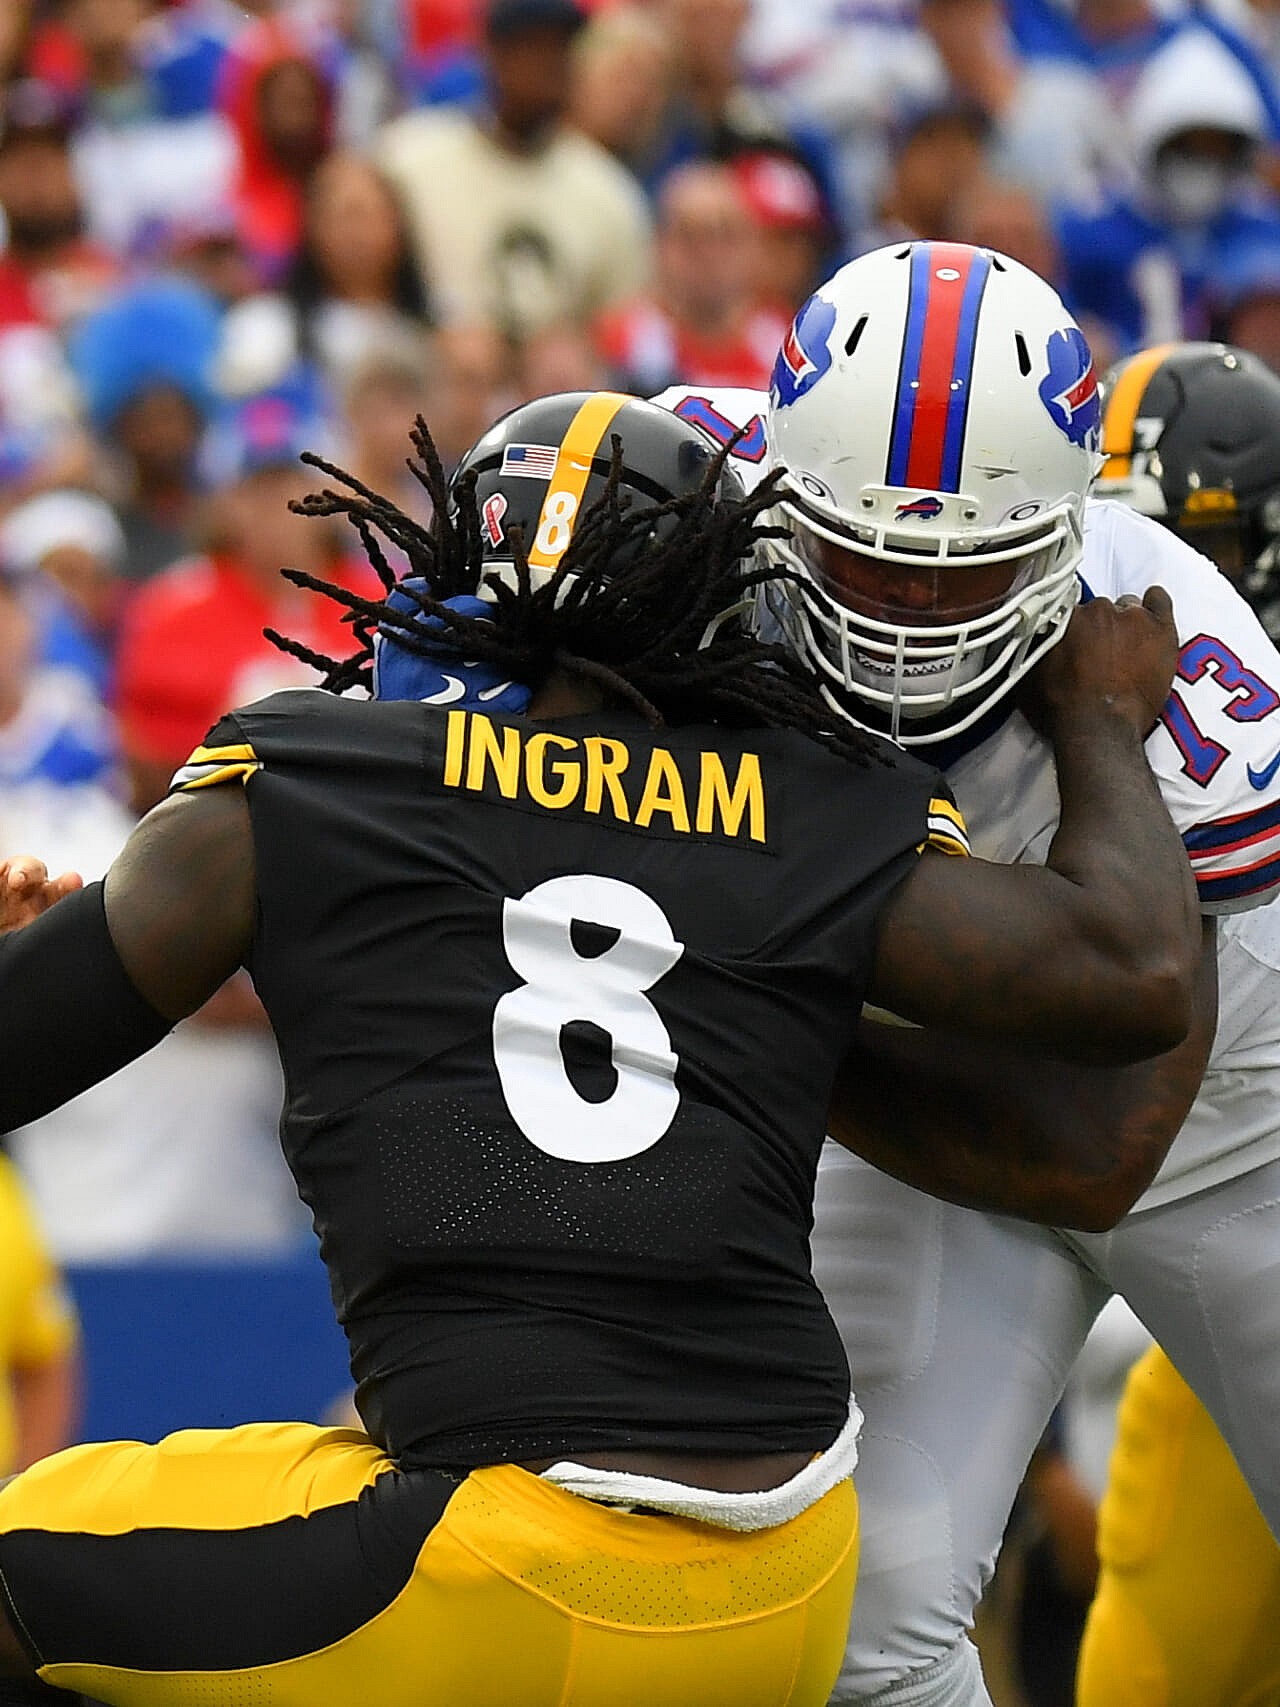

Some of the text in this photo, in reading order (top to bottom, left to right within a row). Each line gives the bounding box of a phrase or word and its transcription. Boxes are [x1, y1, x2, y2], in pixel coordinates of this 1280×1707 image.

[536, 491, 577, 555] 8
[443, 710, 766, 844] INGRAM
[492, 874, 685, 1164] 8
